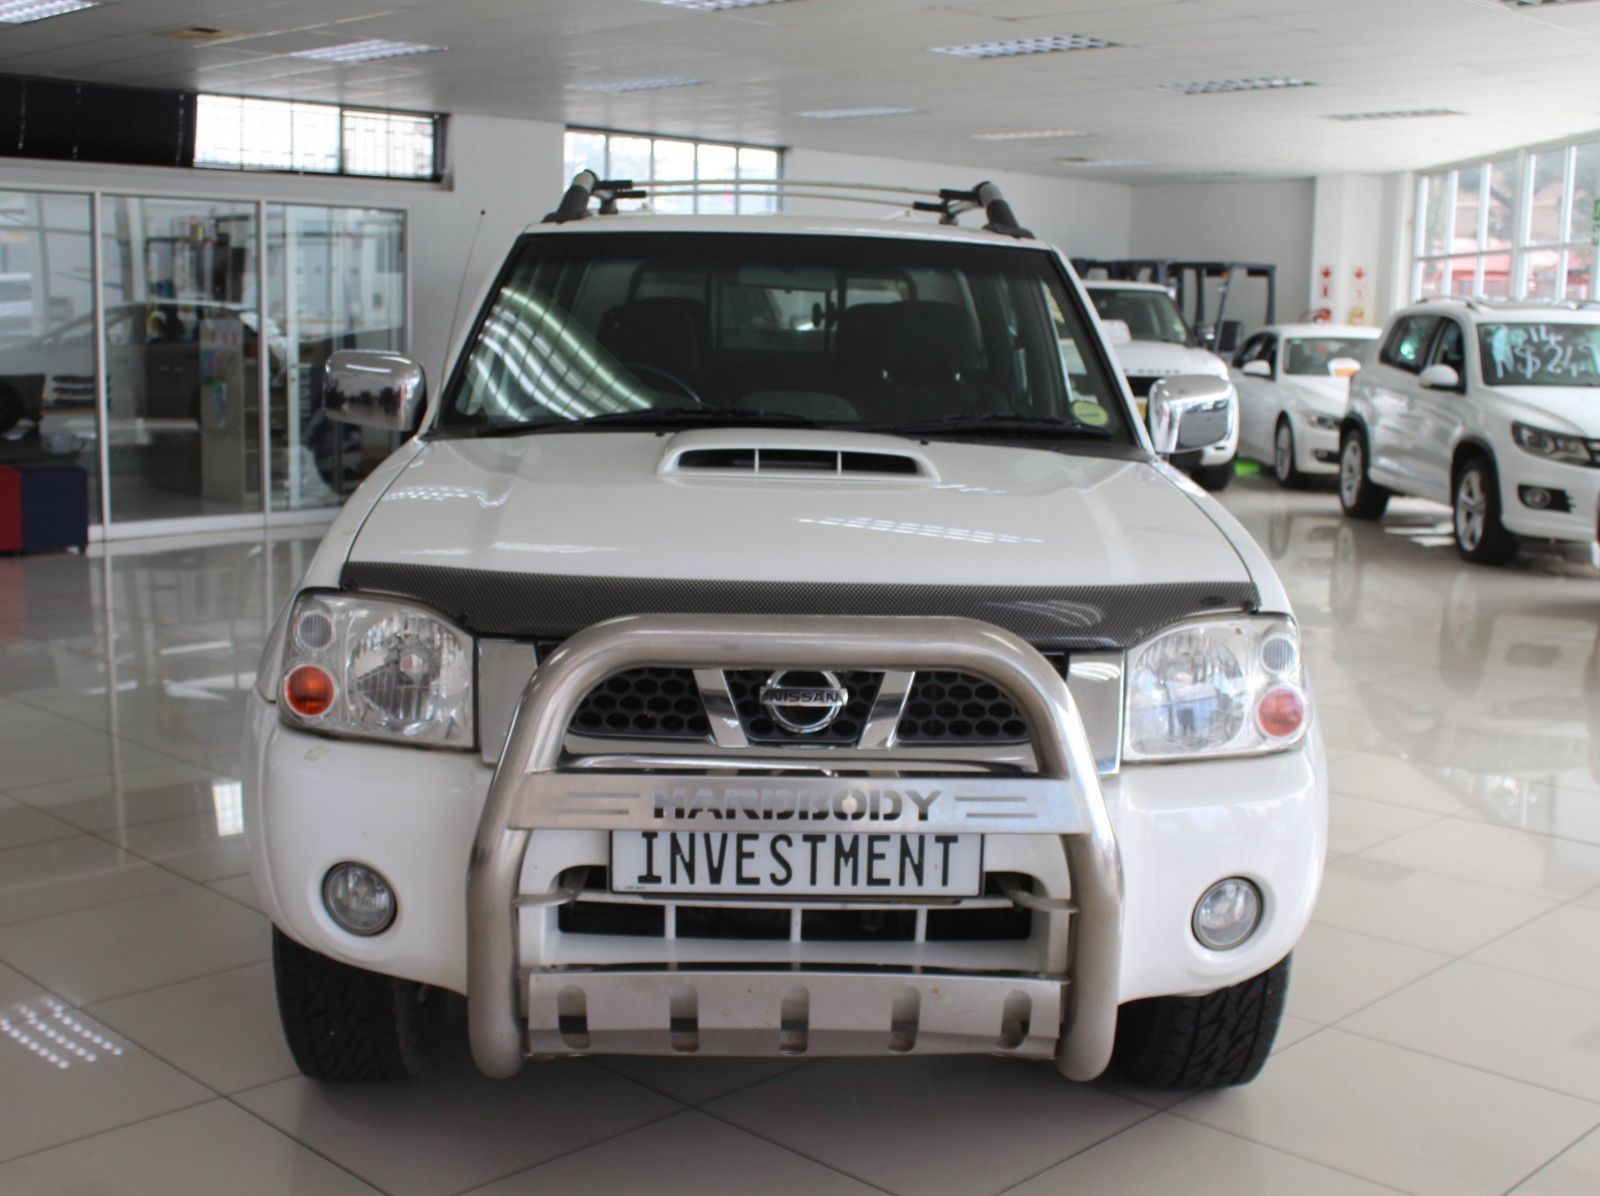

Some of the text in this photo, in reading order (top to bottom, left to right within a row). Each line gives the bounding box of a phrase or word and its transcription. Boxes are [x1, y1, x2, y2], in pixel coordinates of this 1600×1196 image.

[769, 690, 840, 703] NISSAN
[653, 787, 943, 822] HARDBODY
[637, 831, 960, 887] INVESTMENT
